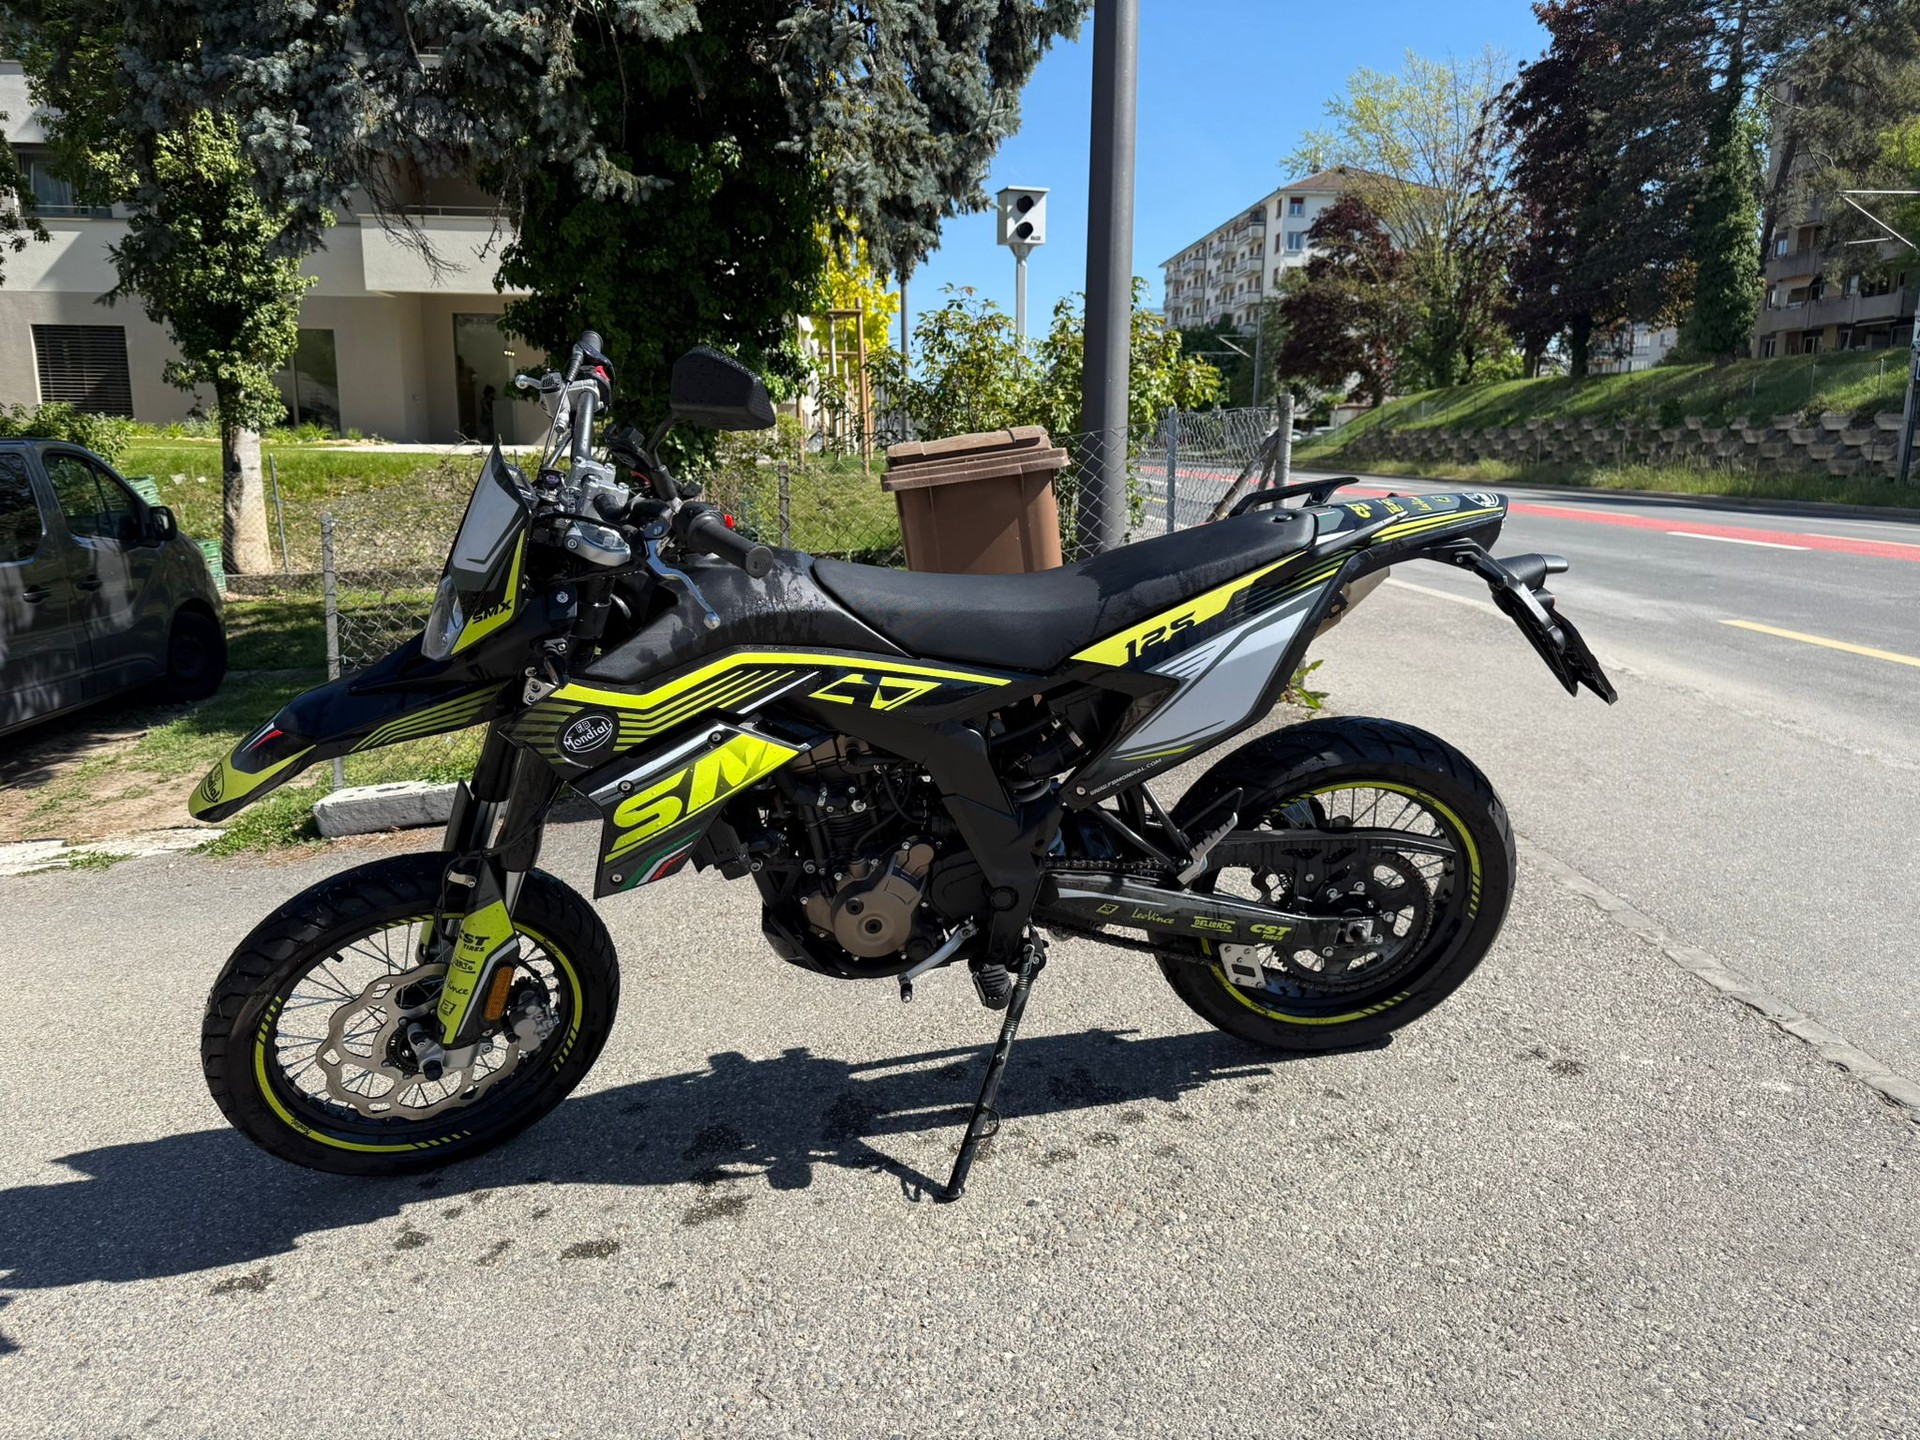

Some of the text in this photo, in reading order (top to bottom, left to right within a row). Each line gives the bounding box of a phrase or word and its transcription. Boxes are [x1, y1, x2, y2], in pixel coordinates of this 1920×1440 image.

[472, 600, 513, 624] SMX
[1125, 610, 1197, 661] 125
[563, 721, 609, 750] Mondial
[1131, 907, 1175, 925] LeoVince
[1250, 923, 1292, 936] CST
[1261, 933, 1284, 941] TIRES
[463, 944, 485, 952] TIRES
